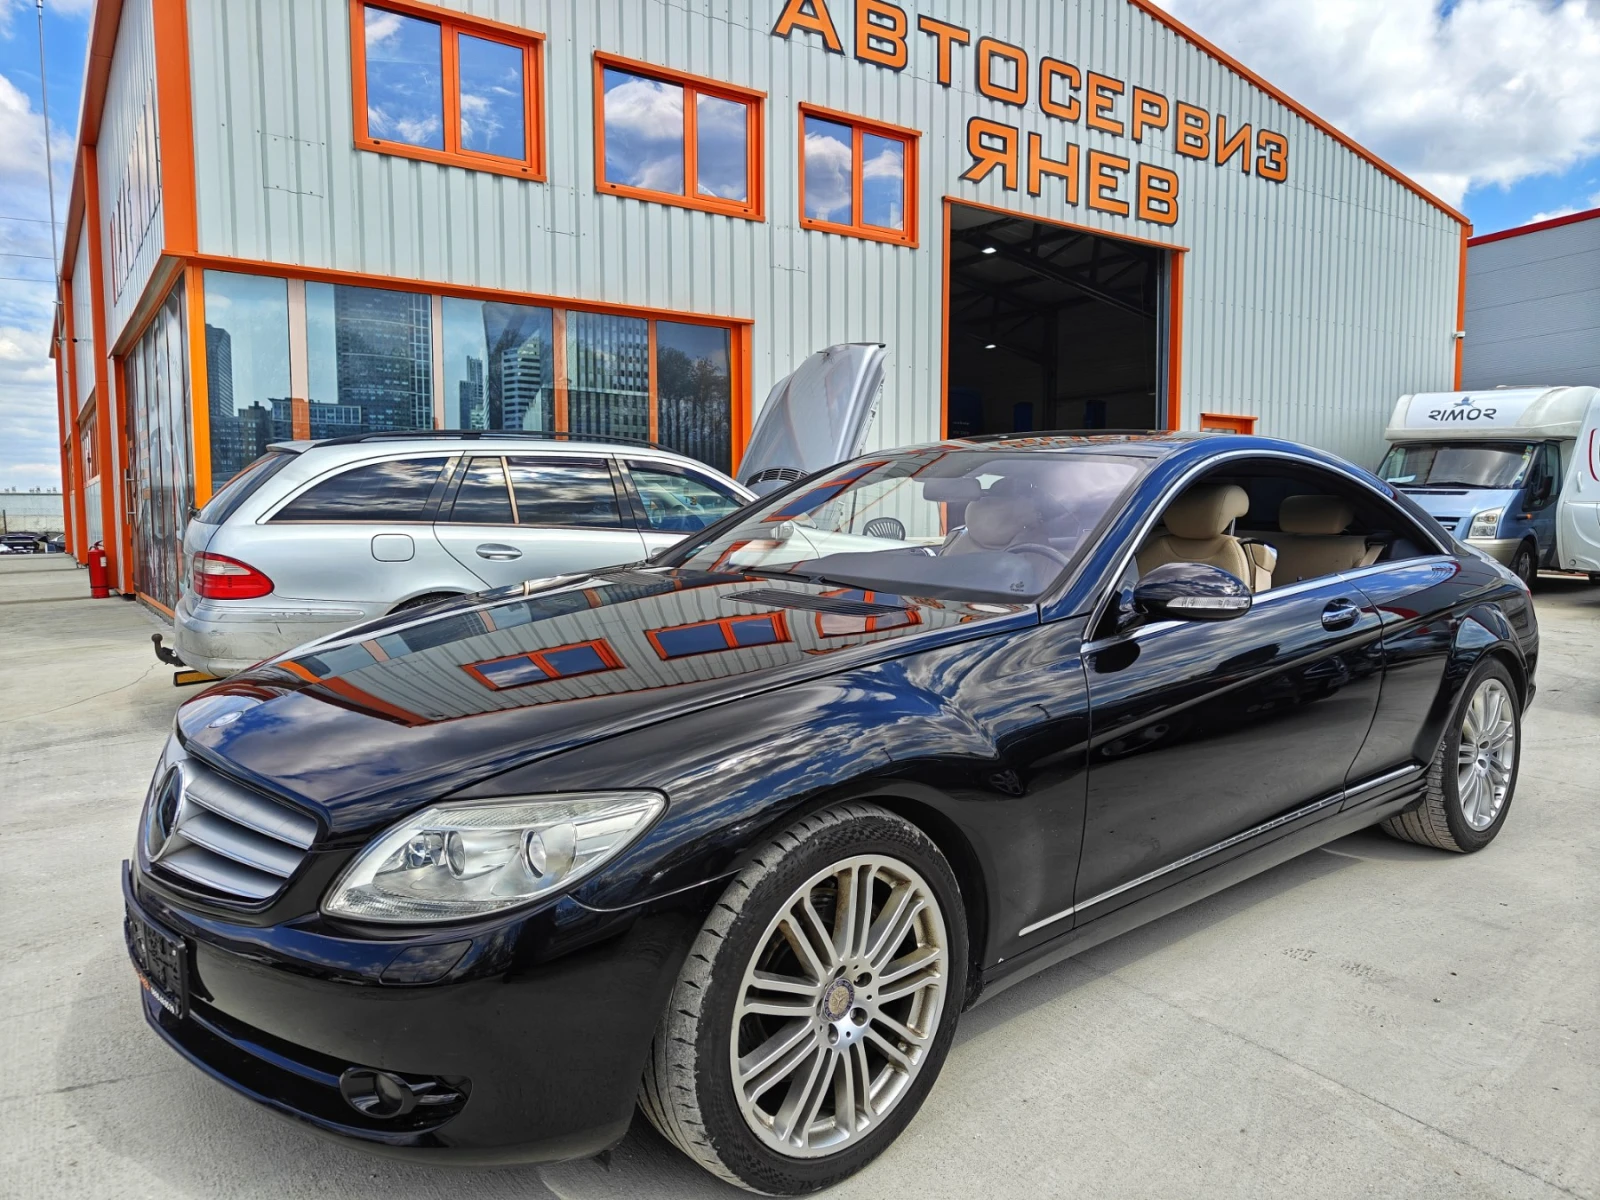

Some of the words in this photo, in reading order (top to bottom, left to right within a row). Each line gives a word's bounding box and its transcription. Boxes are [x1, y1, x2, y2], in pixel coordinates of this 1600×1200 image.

[770, 0, 1289, 183] АВТОСЕРВИЗ
[959, 116, 1180, 227] ЯНЕВ
[1428, 408, 1497, 421] RIMOR
